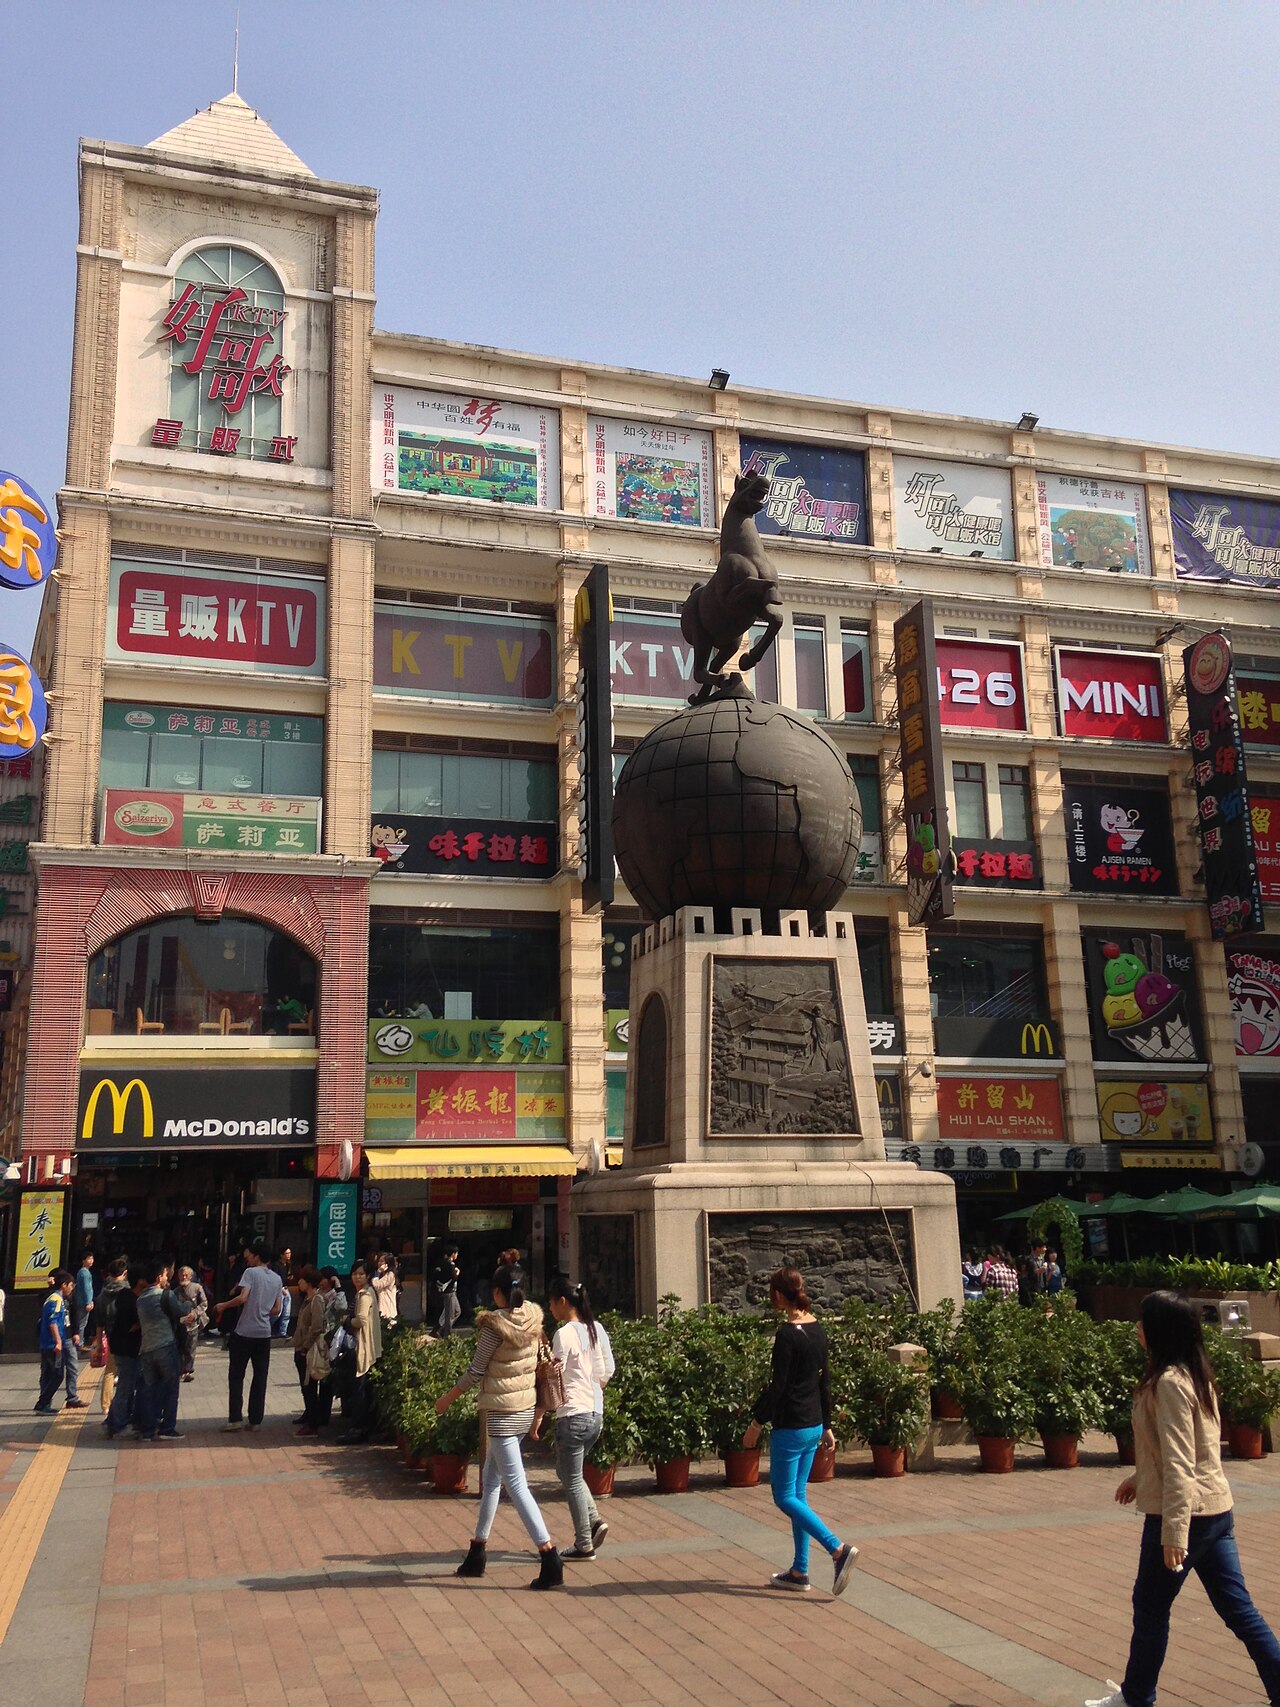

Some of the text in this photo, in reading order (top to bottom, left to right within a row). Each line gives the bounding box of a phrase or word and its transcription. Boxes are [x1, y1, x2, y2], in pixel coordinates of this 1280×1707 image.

[233, 303, 288, 328] KTV
[384, 393, 394, 488] 讲文明树新风 公益广告
[623, 424, 692, 445] 如今好日子
[595, 424, 607, 514] 讲文明树新风 公益广告
[1037, 480, 1049, 527] 讲文明树新风
[129, 588, 304, 648] 量贩KTV
[391, 629, 524, 684] KTV
[609, 639, 695, 681] KTV
[1061, 677, 1160, 717] MINI
[167, 713, 241, 735] 萨莉亚
[121, 810, 168, 825] Saizeriya
[197, 797, 306, 814] 意式餐厅
[196, 823, 305, 847] 萨莉亚
[1101, 855, 1152, 866] AJISEN RAMEN
[420, 1026, 552, 1058] 仙踪林
[955, 1083, 1035, 1110] 許留山
[163, 1117, 310, 1137] McDonald's
[949, 1114, 1046, 1126] HUI LAU SHAN
